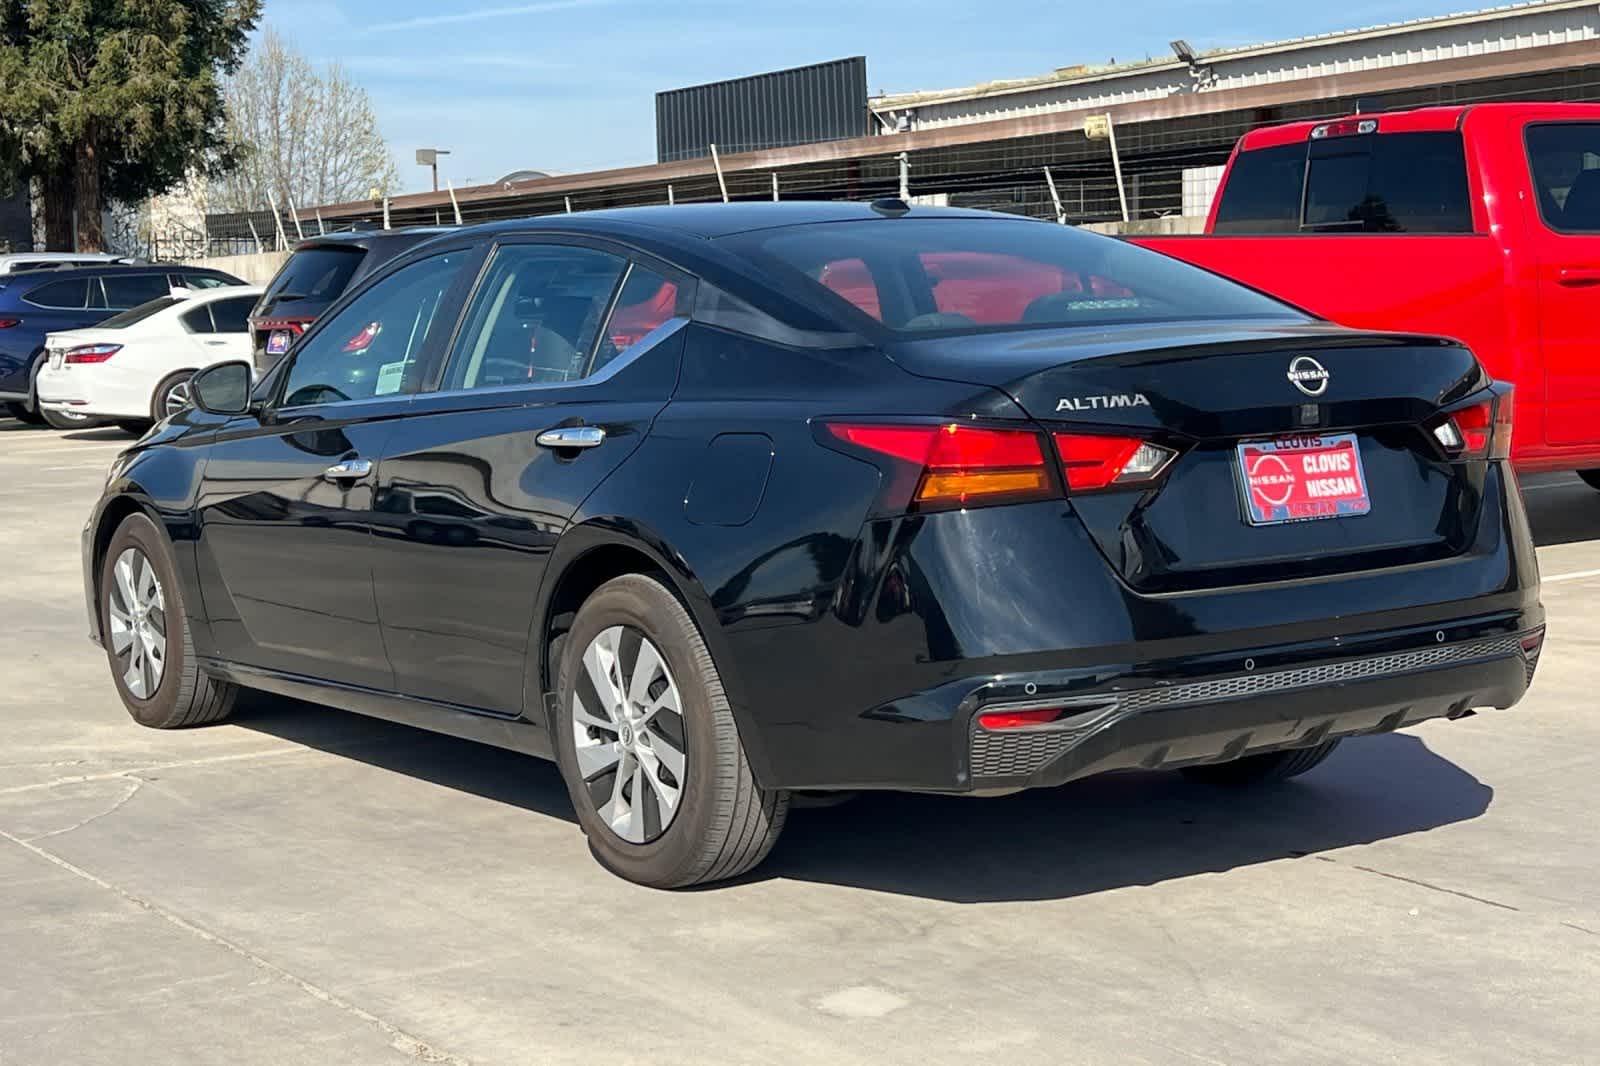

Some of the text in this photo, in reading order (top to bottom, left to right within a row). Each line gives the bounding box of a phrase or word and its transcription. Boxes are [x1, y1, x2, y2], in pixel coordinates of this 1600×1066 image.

[1287, 370, 1329, 381] NISSAN
[1055, 393, 1151, 412] ALTIMA
[1303, 453, 1350, 474] CLOVIS
[1248, 474, 1295, 485] NISSAN
[1307, 478, 1356, 498] NISSAN
